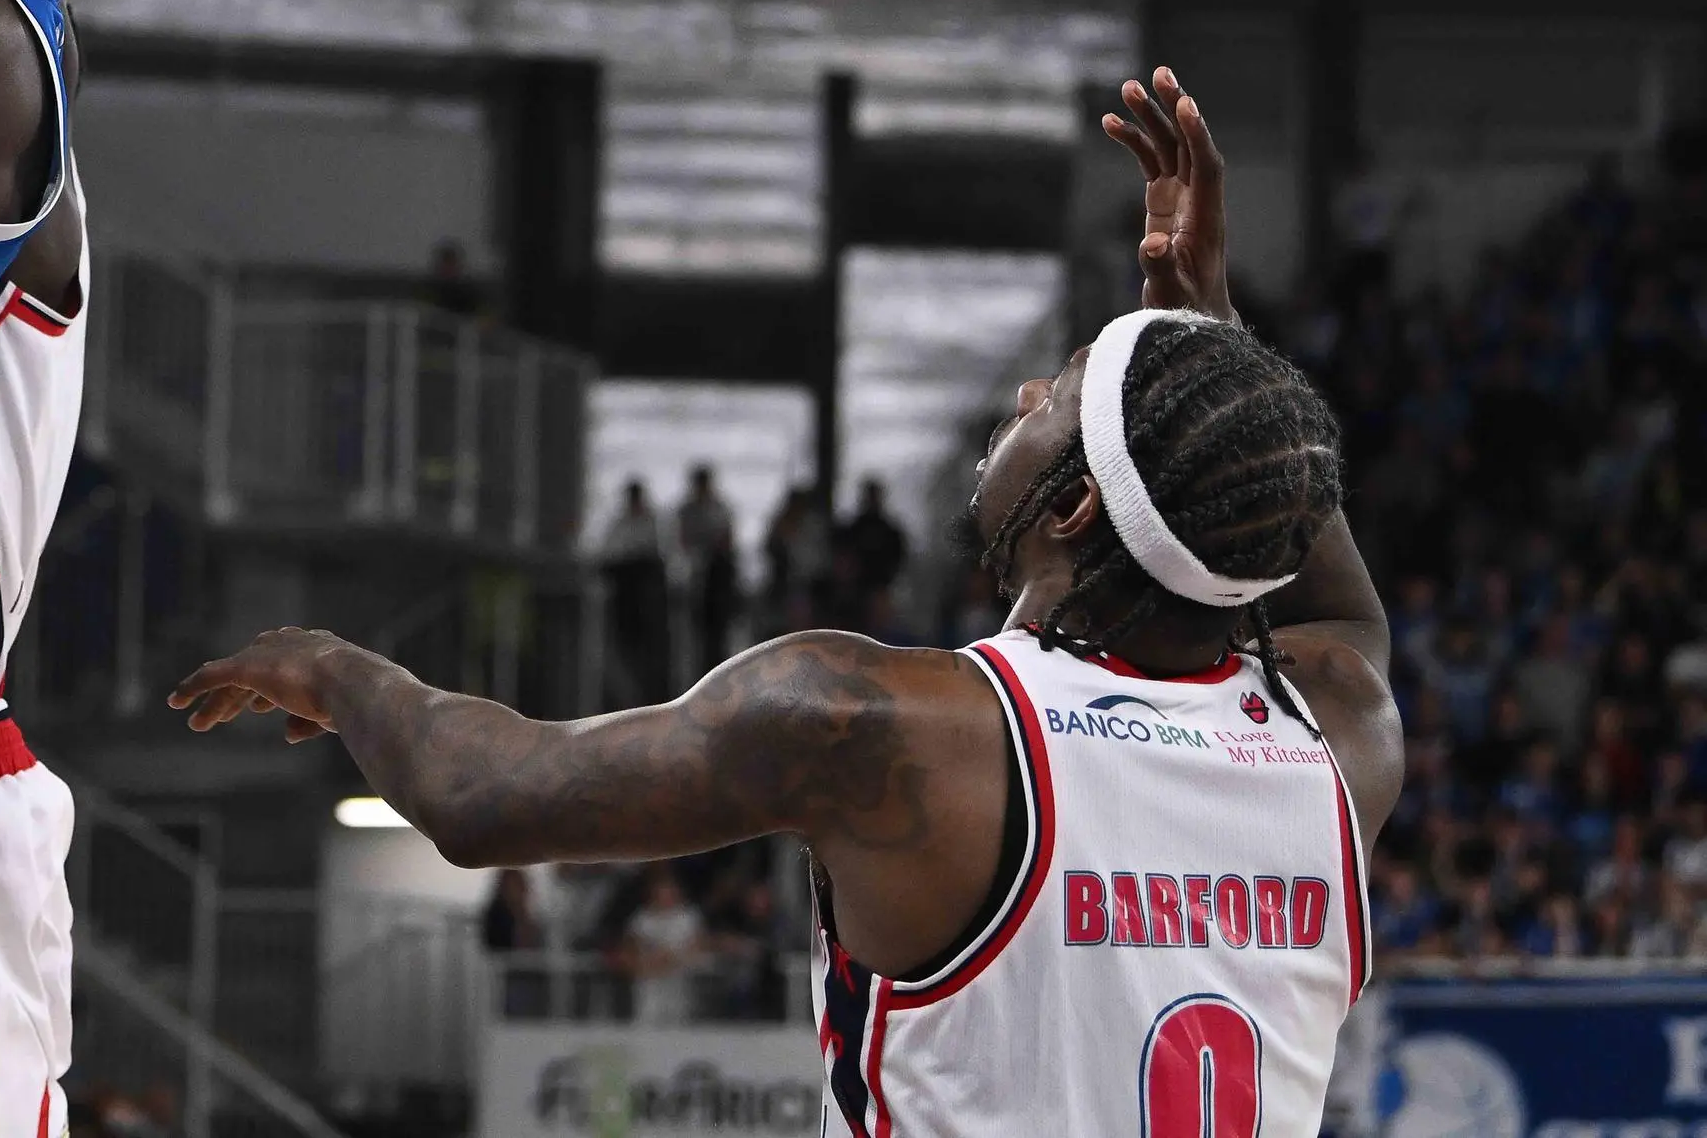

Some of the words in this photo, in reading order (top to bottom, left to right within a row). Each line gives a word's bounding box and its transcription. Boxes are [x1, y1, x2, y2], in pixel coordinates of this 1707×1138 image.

[1044, 708, 1151, 742] BANCO
[1153, 723, 1211, 749] BPM
[1225, 731, 1275, 743] Love
[1227, 746, 1256, 767] My
[1064, 870, 1330, 949] BARFORD
